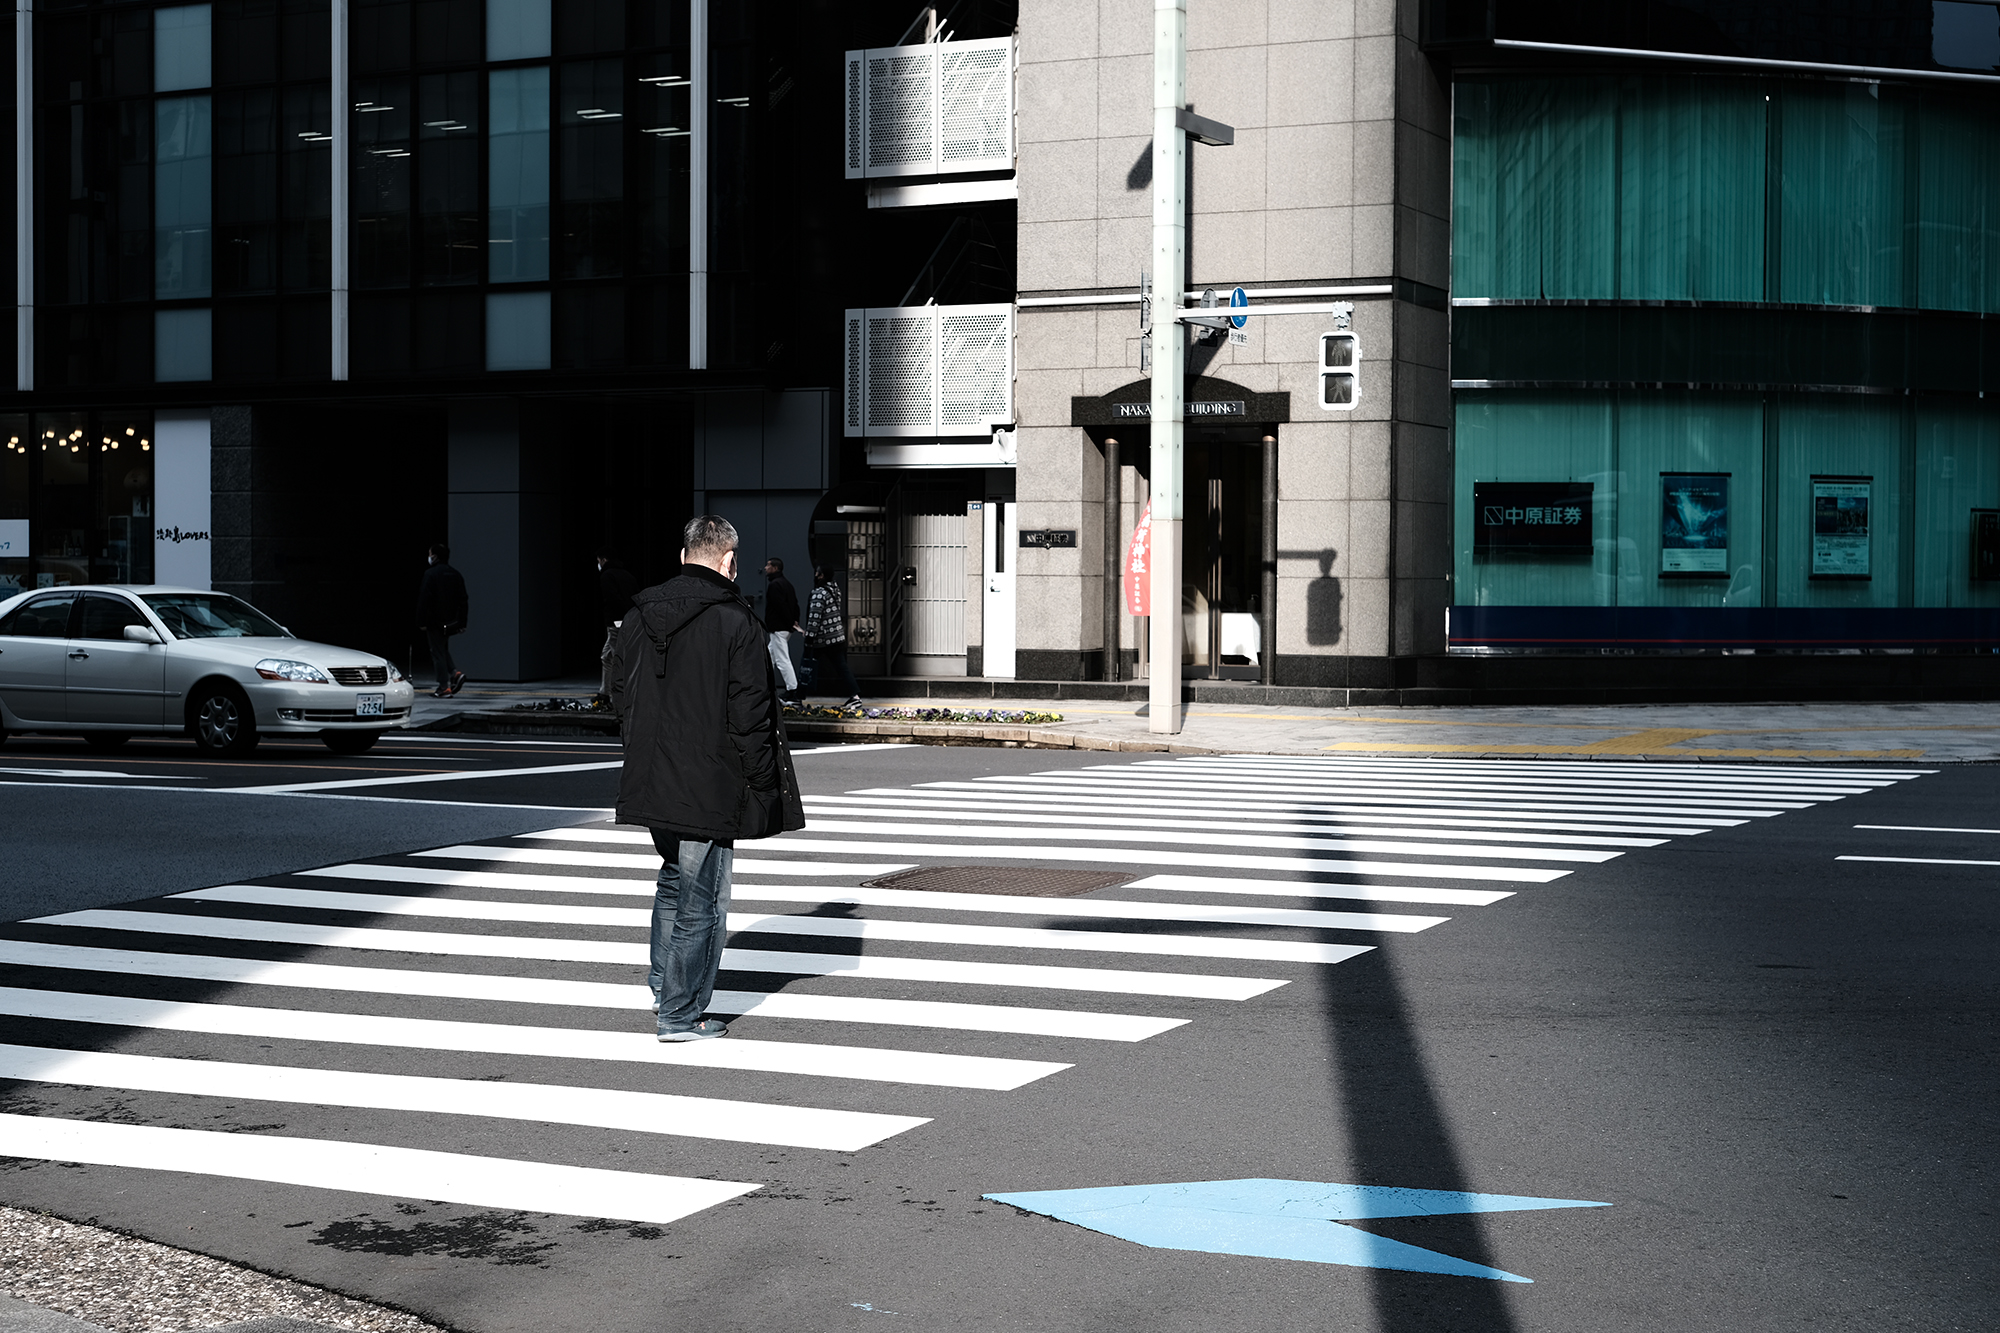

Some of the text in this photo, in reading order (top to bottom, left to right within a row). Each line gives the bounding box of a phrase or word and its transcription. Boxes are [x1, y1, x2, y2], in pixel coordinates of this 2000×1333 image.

[1120, 402, 1237, 416] NAKA BUILDING
[1505, 506, 1582, 526] 中原証券
[362, 702, 383, 714] 22-54
